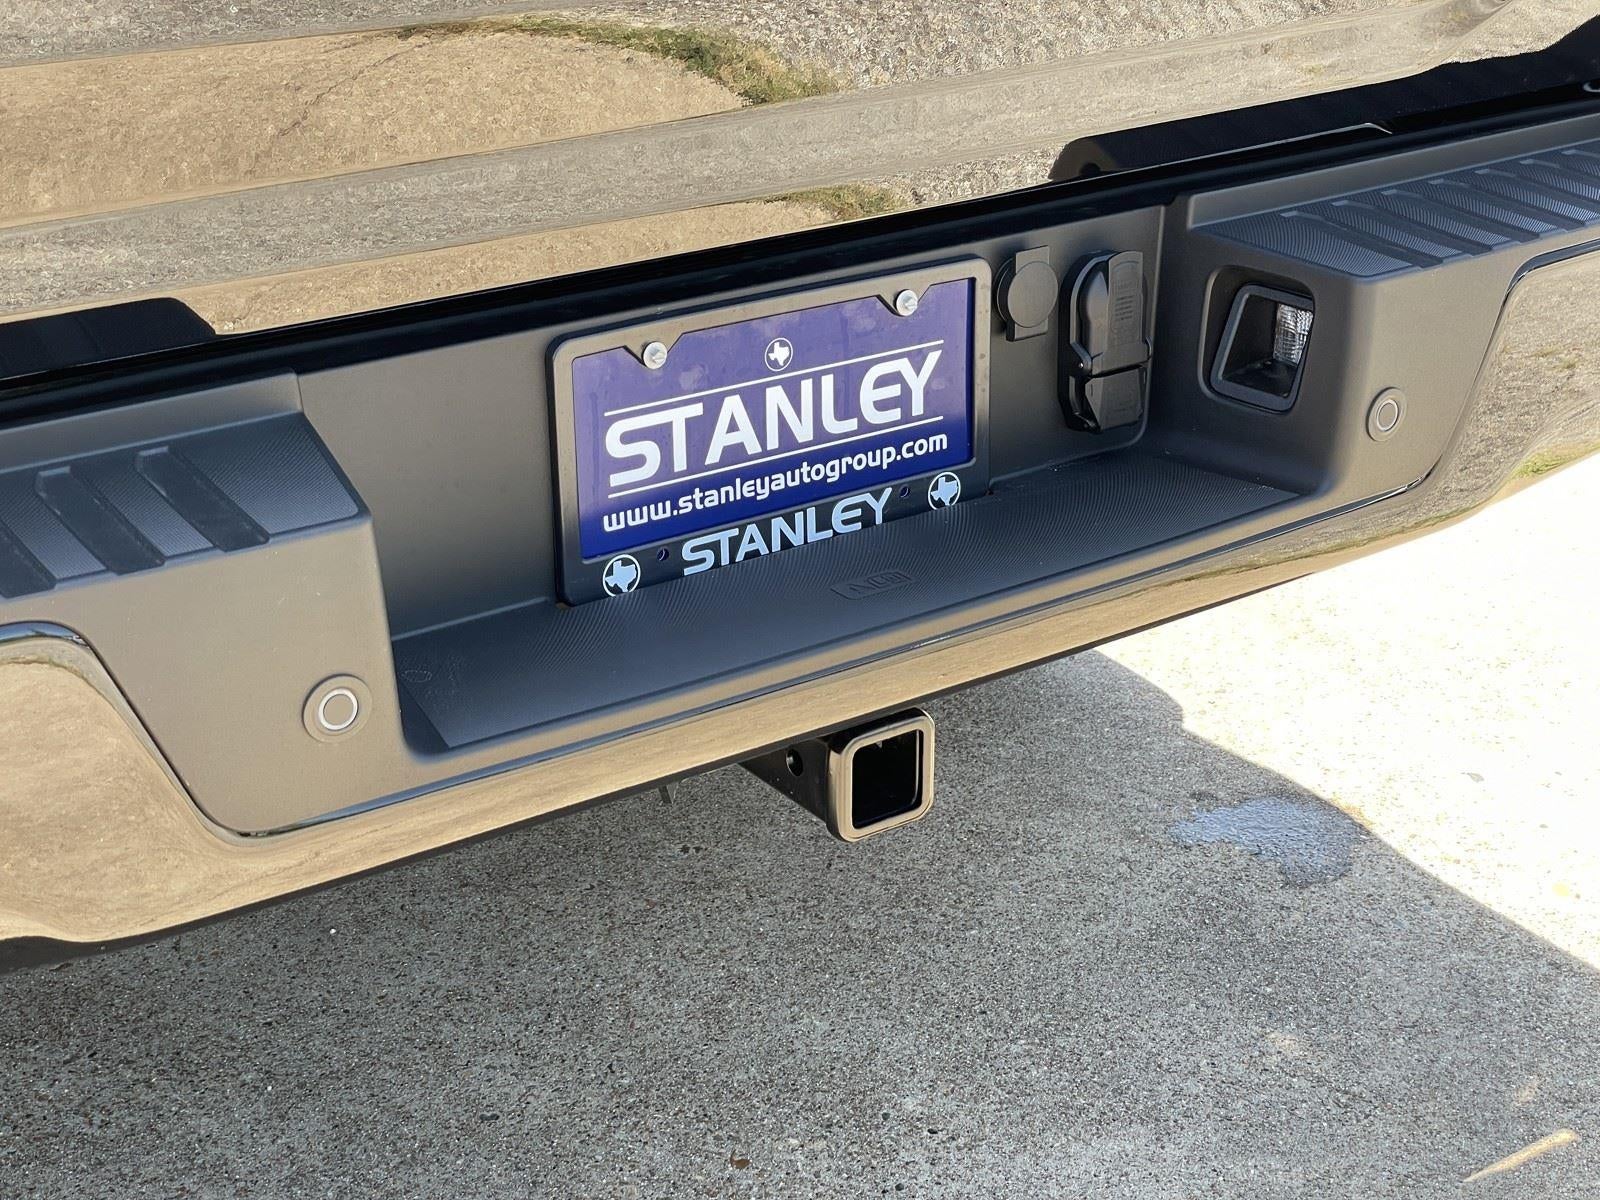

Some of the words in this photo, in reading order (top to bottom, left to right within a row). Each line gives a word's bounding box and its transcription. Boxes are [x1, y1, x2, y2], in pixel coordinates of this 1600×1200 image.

[605, 350, 942, 486] STANLEY
[603, 435, 948, 531] www.stanleyautogroup.com
[681, 487, 892, 576] STANLEY
